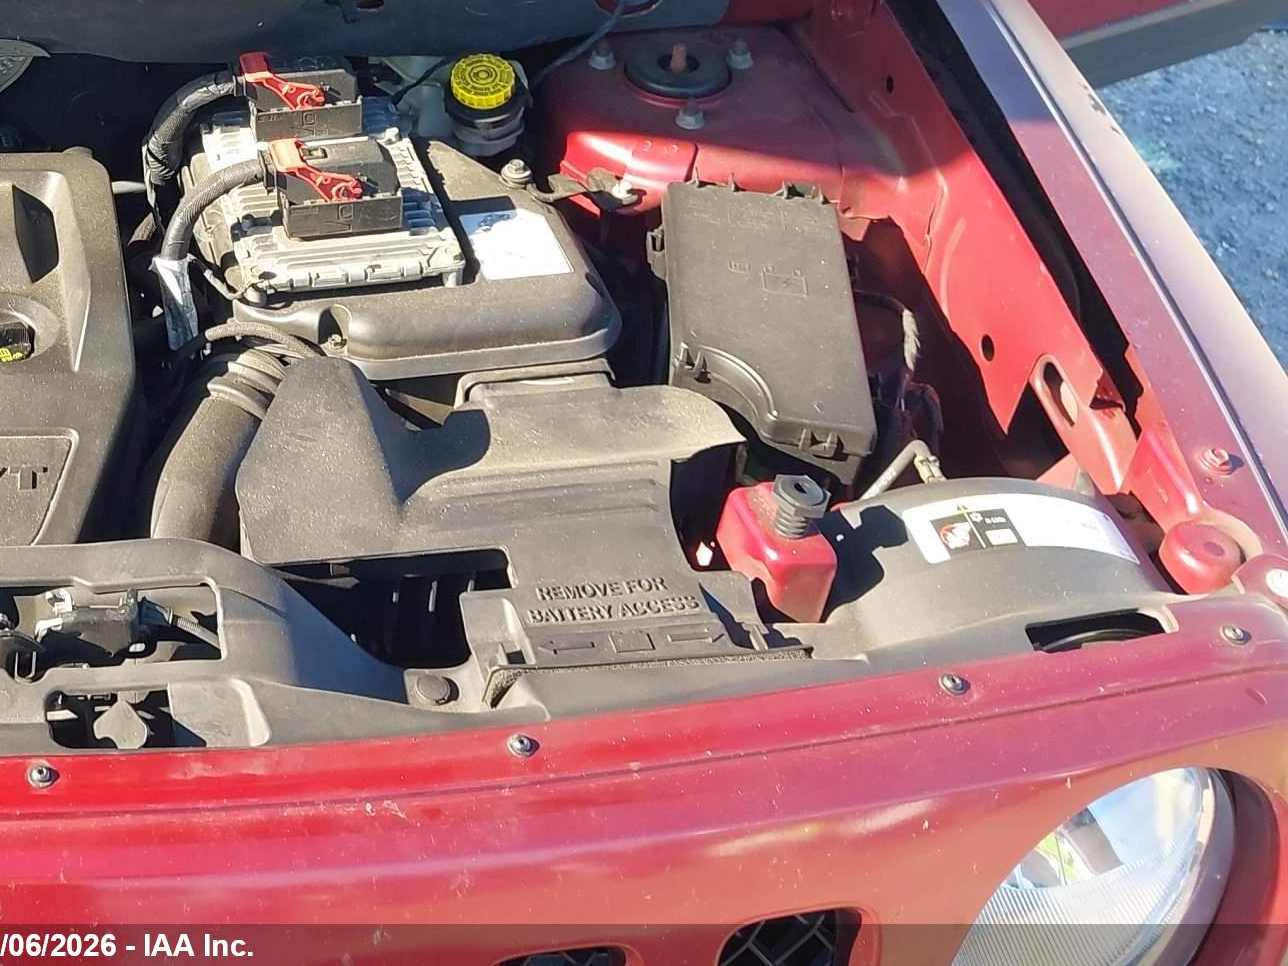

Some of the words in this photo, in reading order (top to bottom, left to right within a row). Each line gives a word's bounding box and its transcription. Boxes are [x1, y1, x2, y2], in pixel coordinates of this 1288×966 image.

[536, 582, 623, 601] REMOVE
[624, 576, 668, 595] FOR
[527, 604, 612, 624] BATTERY
[617, 594, 700, 618] ACCESS
